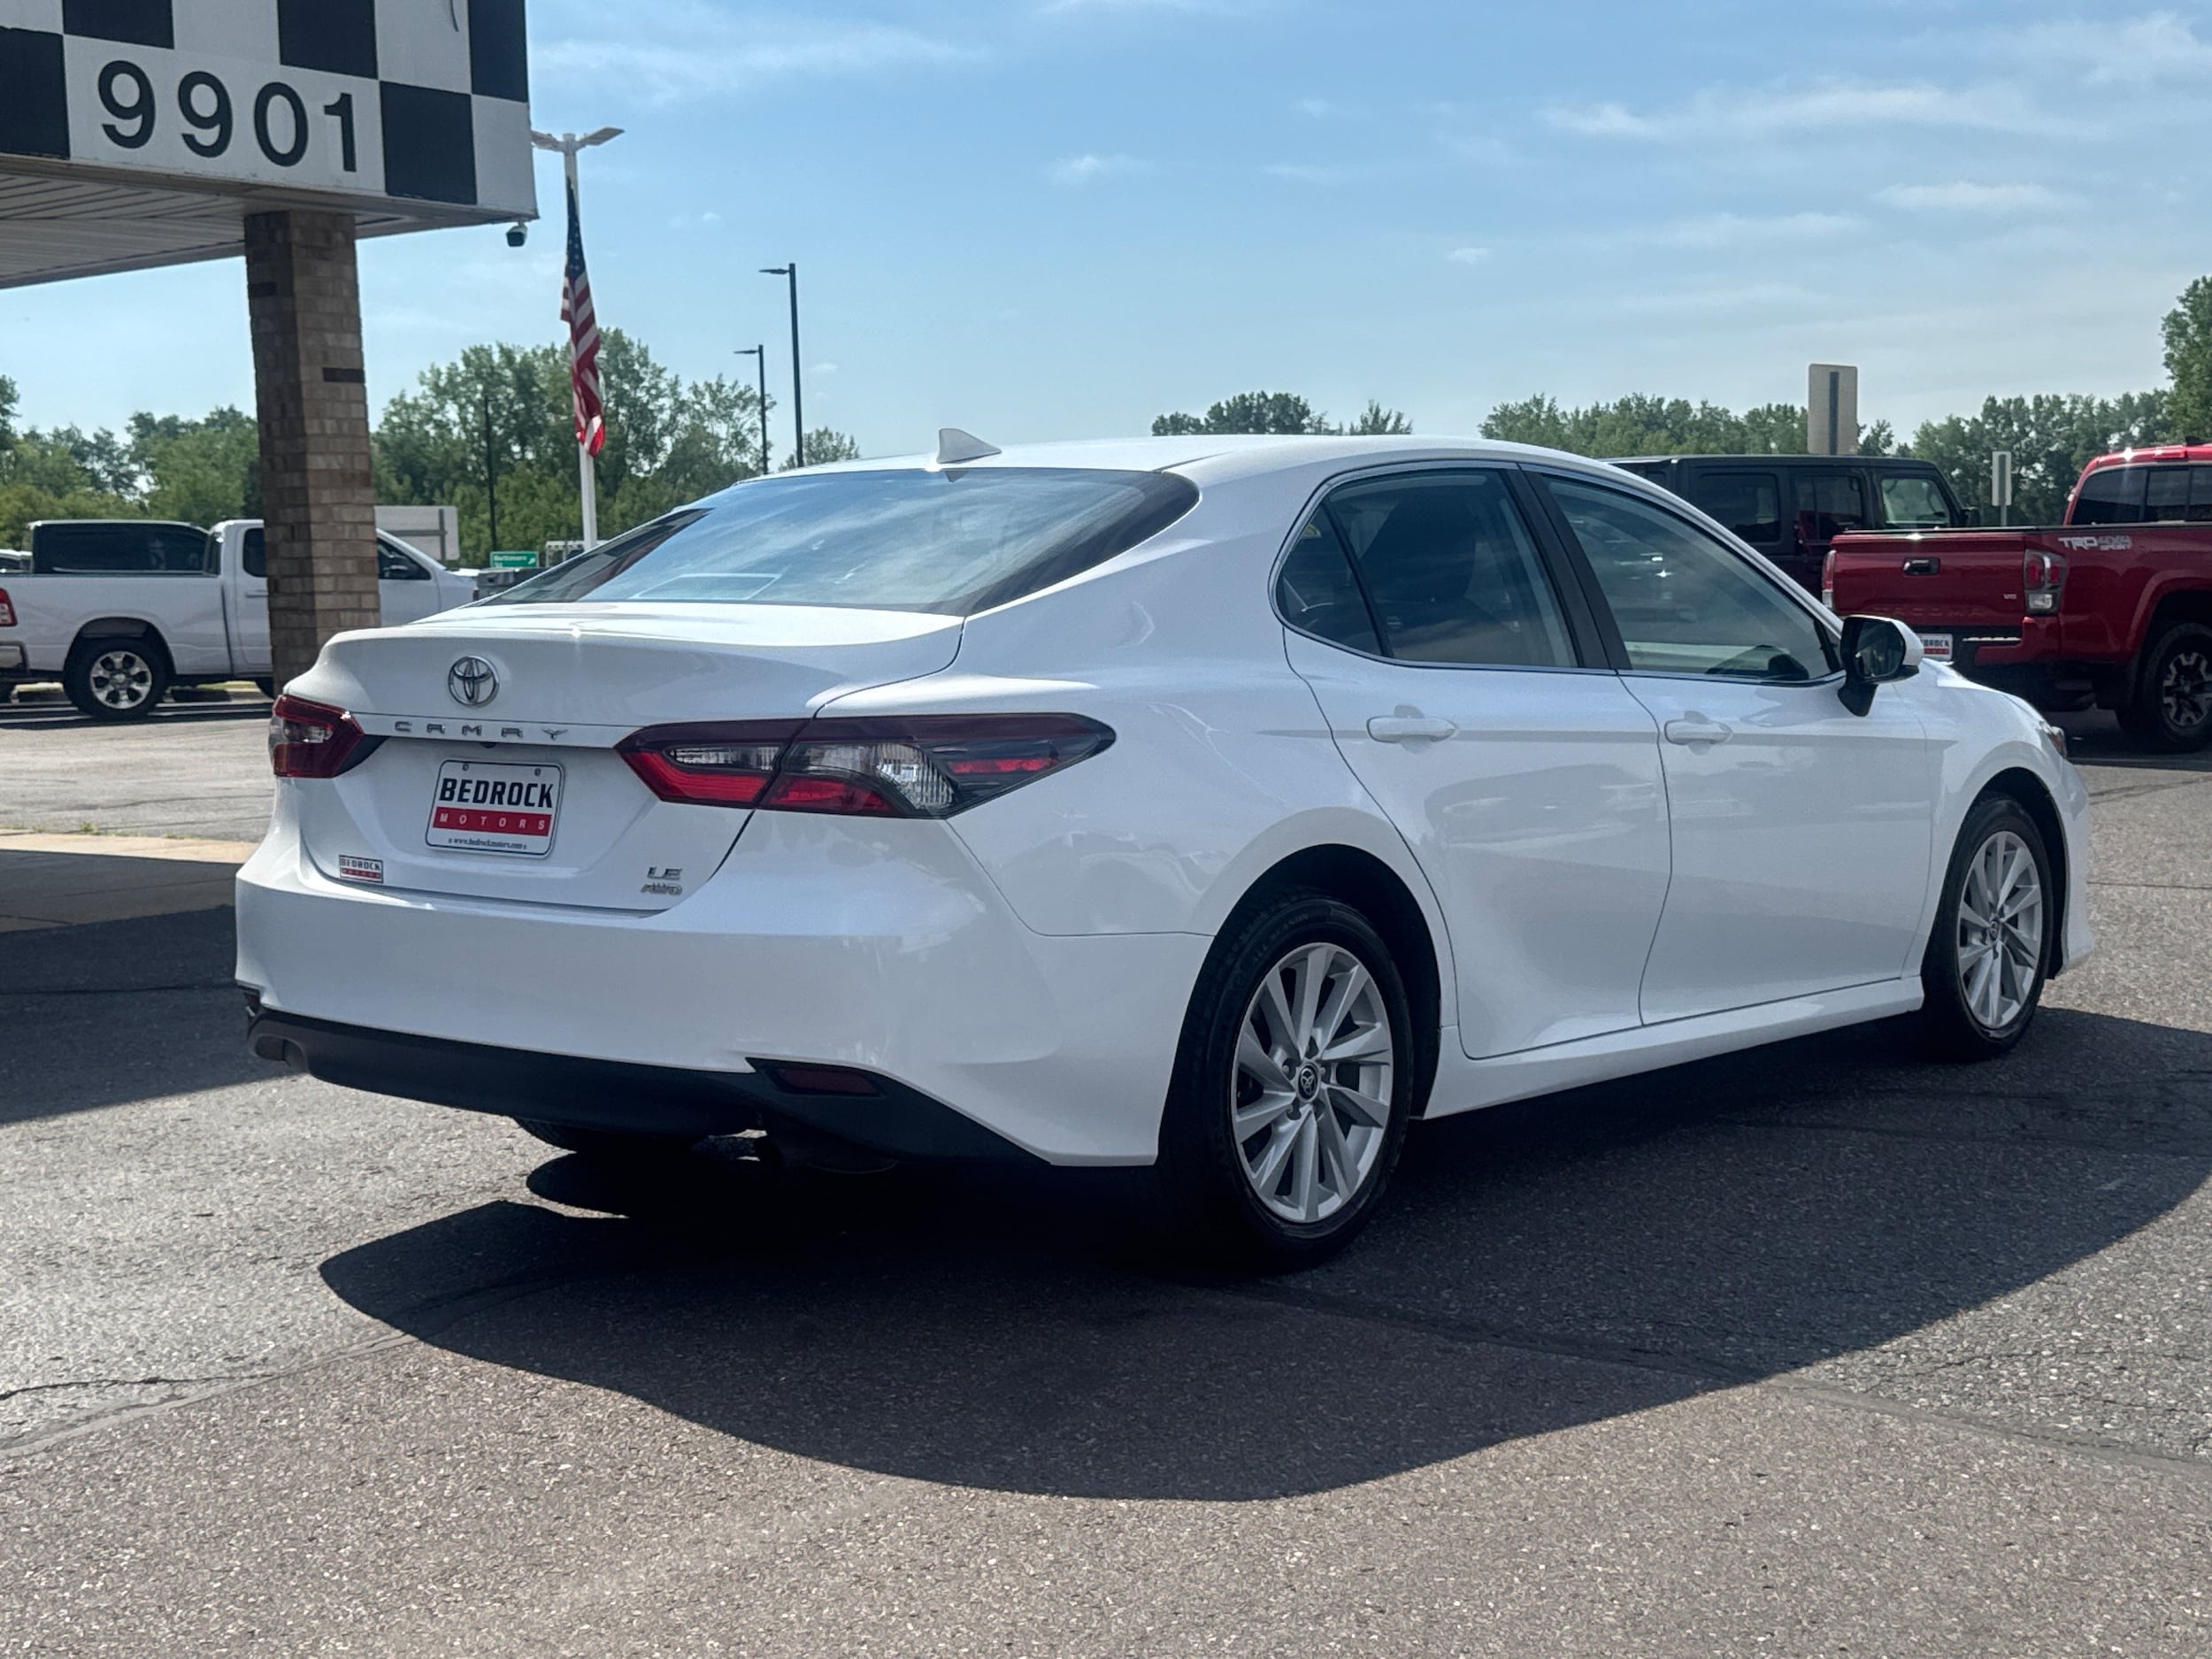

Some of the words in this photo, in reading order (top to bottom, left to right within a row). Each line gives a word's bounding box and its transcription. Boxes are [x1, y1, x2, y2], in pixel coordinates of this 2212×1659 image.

[97, 59, 357, 173] 9901
[394, 720, 570, 741] CAMRY
[439, 777, 555, 809] BEDROCK
[439, 813, 546, 831] MOTORS
[340, 858, 380, 871] BEDROCK
[647, 866, 683, 881] LE
